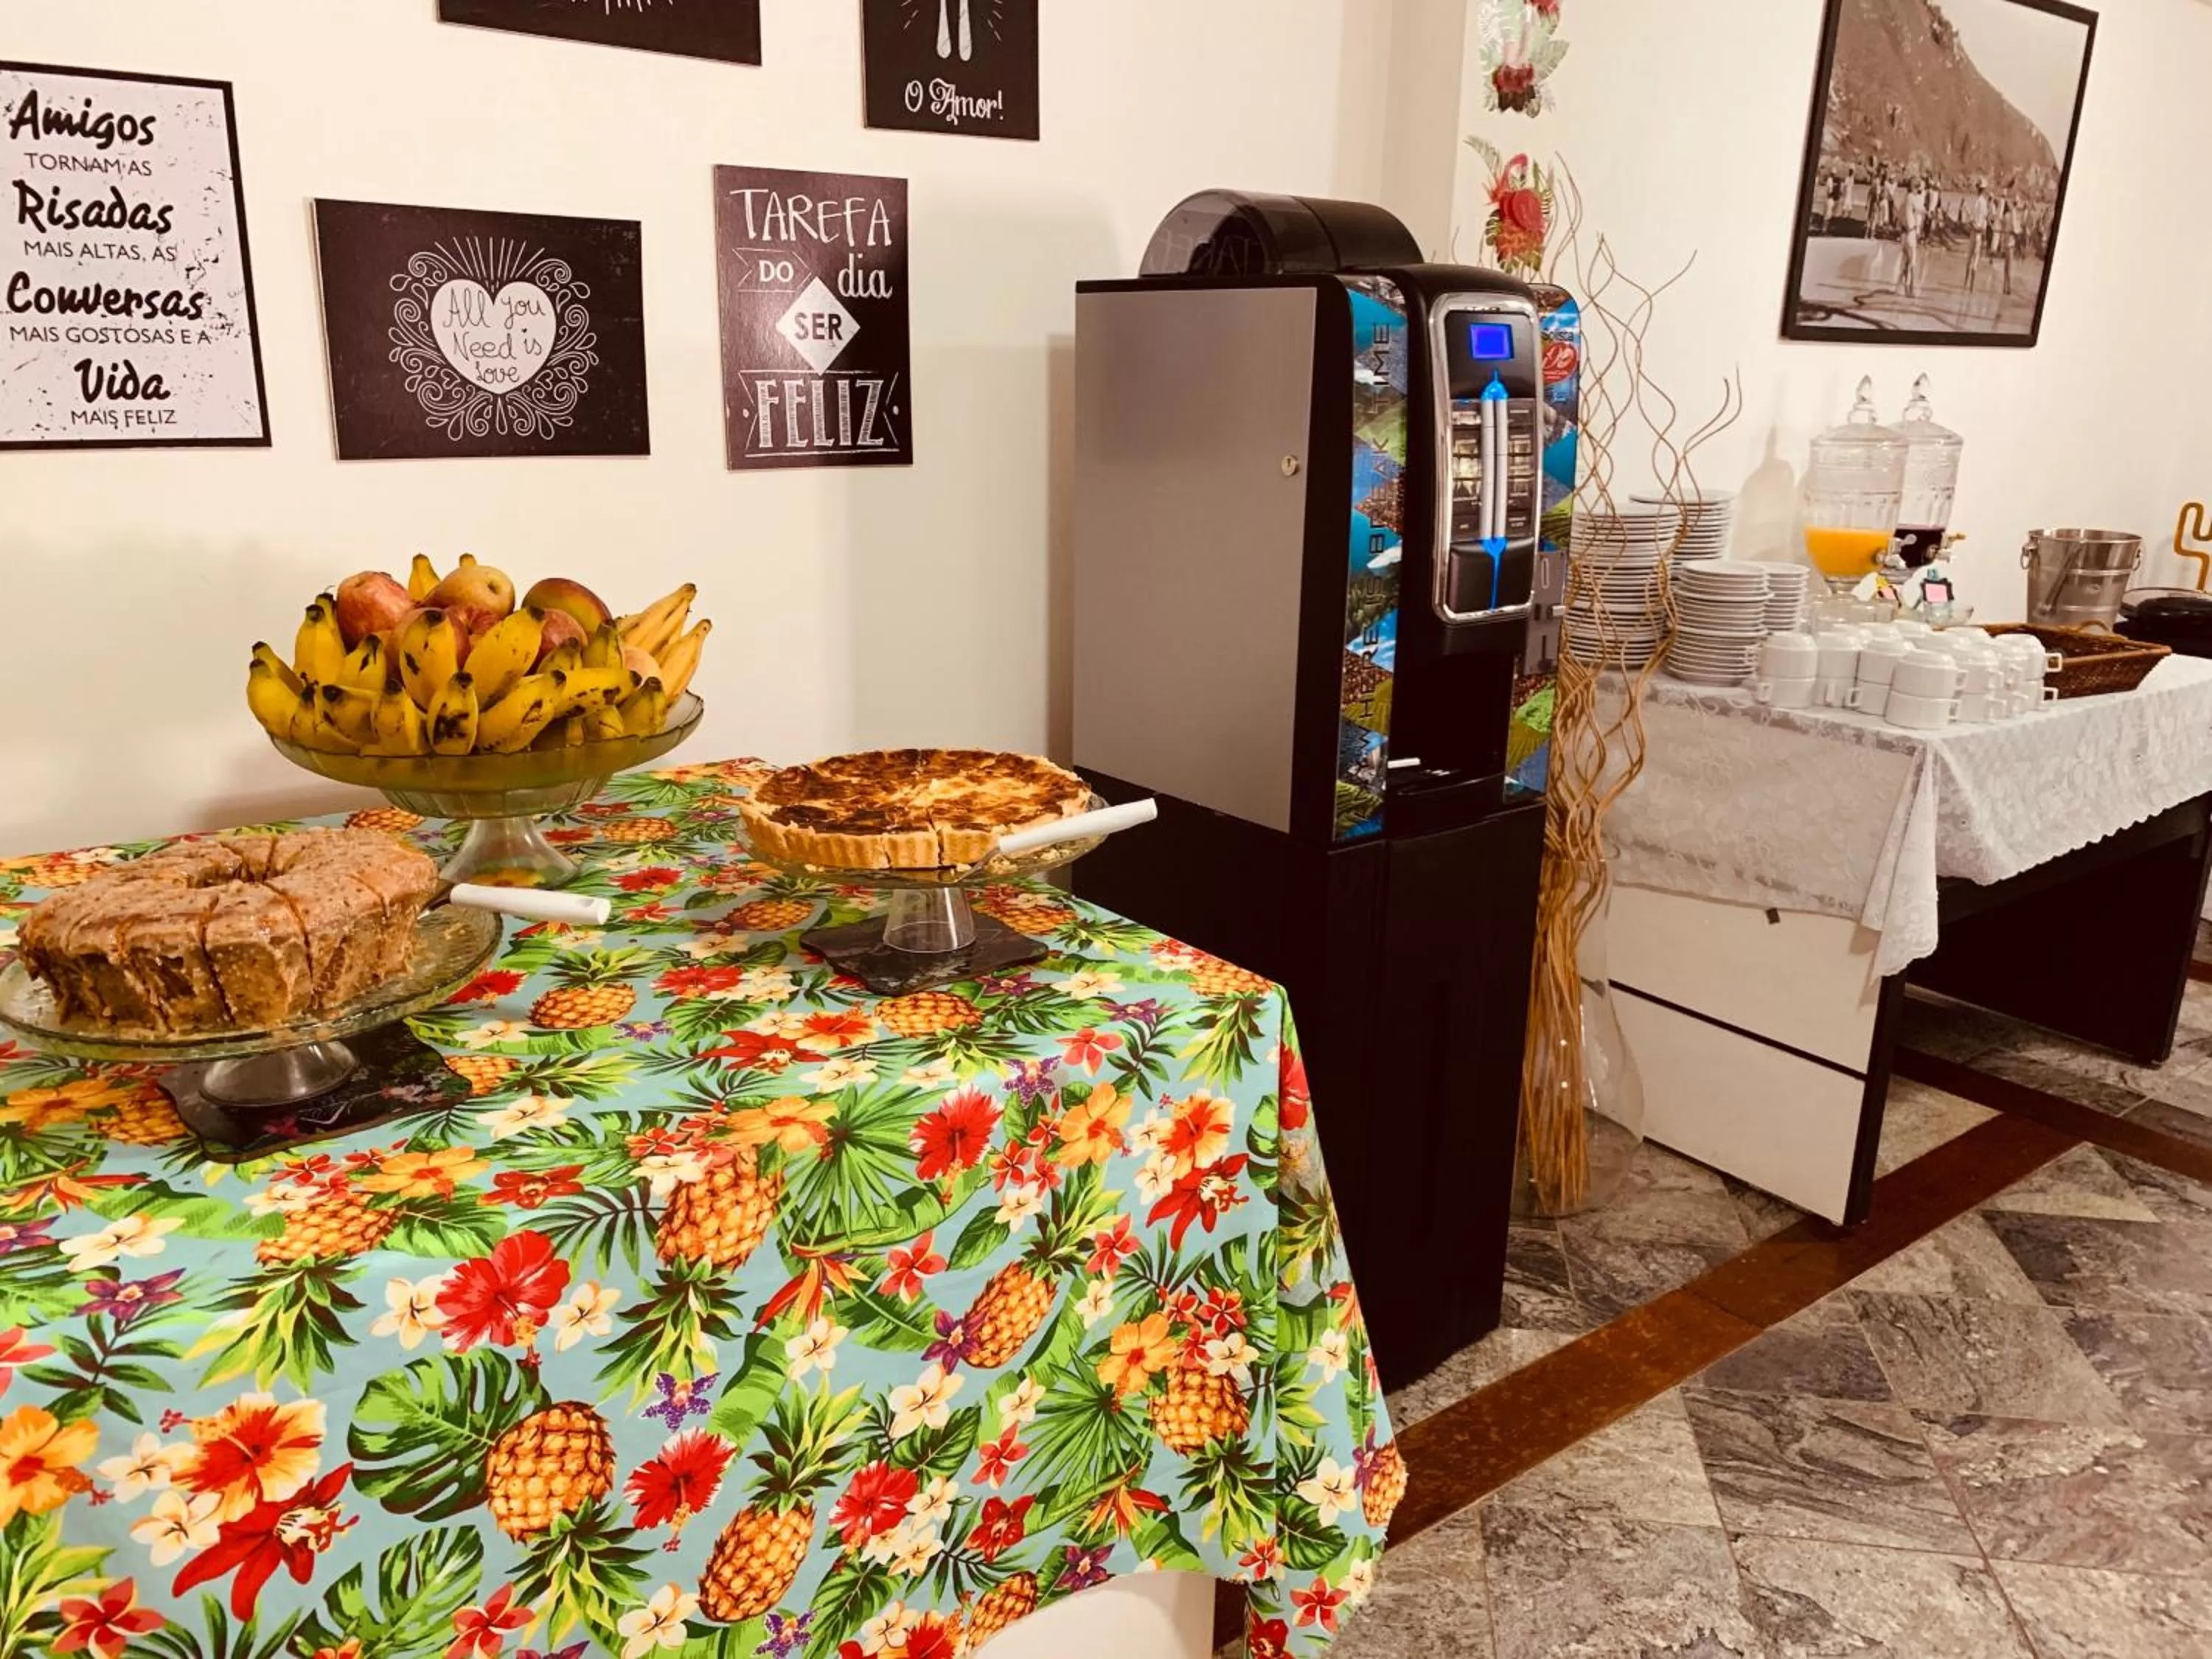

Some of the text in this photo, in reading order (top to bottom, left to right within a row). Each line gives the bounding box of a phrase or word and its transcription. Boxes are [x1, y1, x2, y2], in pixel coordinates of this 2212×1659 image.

[10, 89, 156, 148] Amigos
[905, 77, 1004, 125] O Amor!
[24, 153, 153, 176] TORNAM AS
[12, 179, 174, 234] Risadas
[730, 188, 891, 246] TAREFA
[24, 241, 73, 257] MAIS
[152, 246, 176, 262] AS
[7, 271, 204, 320] Conversas
[759, 253, 893, 299] DO dia
[443, 288, 490, 327] All
[794, 313, 843, 340] SER
[10, 327, 212, 344] MAIS GOSTOSAS E A
[453, 327, 542, 361] Need is
[74, 358, 171, 402] Vida
[1371, 323, 1390, 414] TIME
[72, 409, 177, 425] MAIS FELIZ
[756, 379, 884, 448] FELIZ
